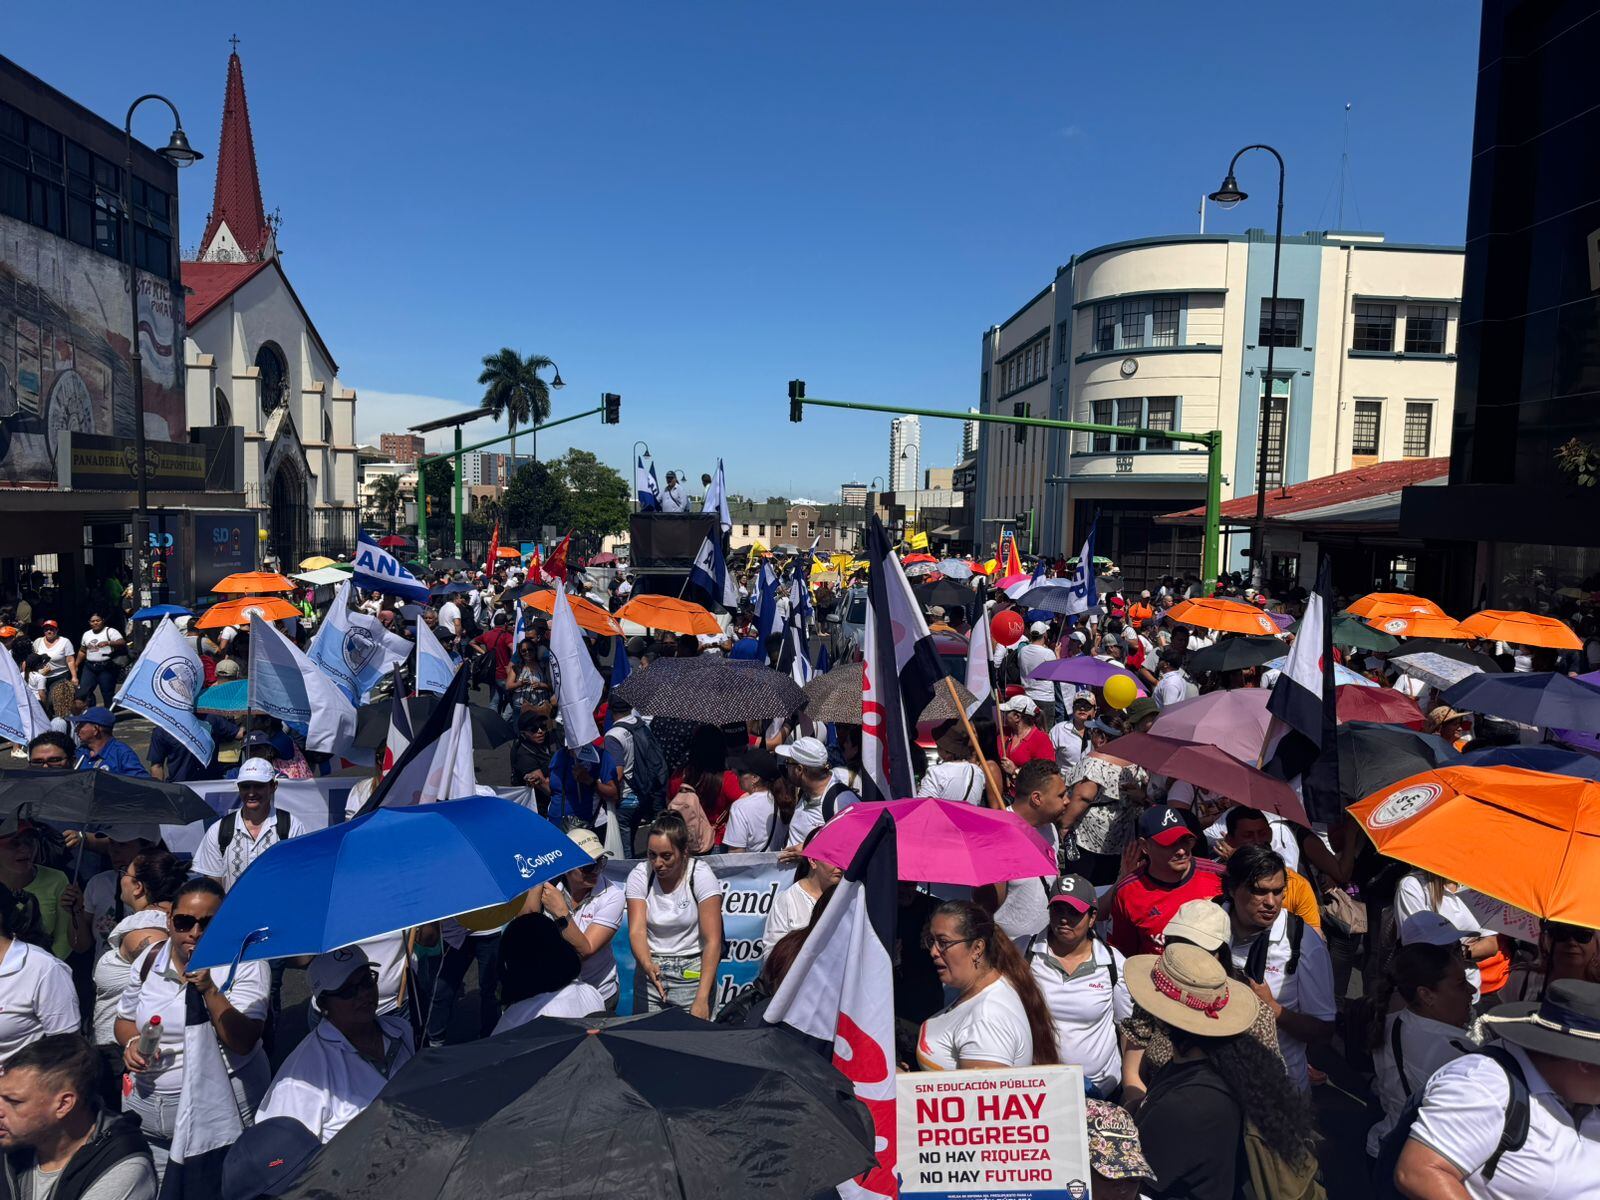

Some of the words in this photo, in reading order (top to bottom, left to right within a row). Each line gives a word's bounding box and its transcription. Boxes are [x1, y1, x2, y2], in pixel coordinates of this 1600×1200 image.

[124, 278, 151, 296] CSTA
[73, 454, 125, 467] PANADERÍA
[160, 460, 202, 472] REPOSTERÍA
[1162, 808, 1178, 826] A
[527, 850, 562, 868] Colypro
[1062, 878, 1075, 892] S
[916, 1084, 934, 1092] SIN
[938, 1080, 996, 1092] EDUCACIÓN
[1000, 1078, 1046, 1089] PÚBLICA
[916, 1097, 964, 1124] NO
[977, 1093, 1046, 1121] HAY
[918, 1125, 1050, 1146] PROGRESO
[920, 1152, 940, 1164] NO
[946, 1150, 976, 1162] HAY
[981, 1149, 1050, 1164] RIQUEZA
[920, 1172, 942, 1184] NO
[948, 1170, 980, 1182] HAY
[986, 1168, 1052, 1182] FUTURO
